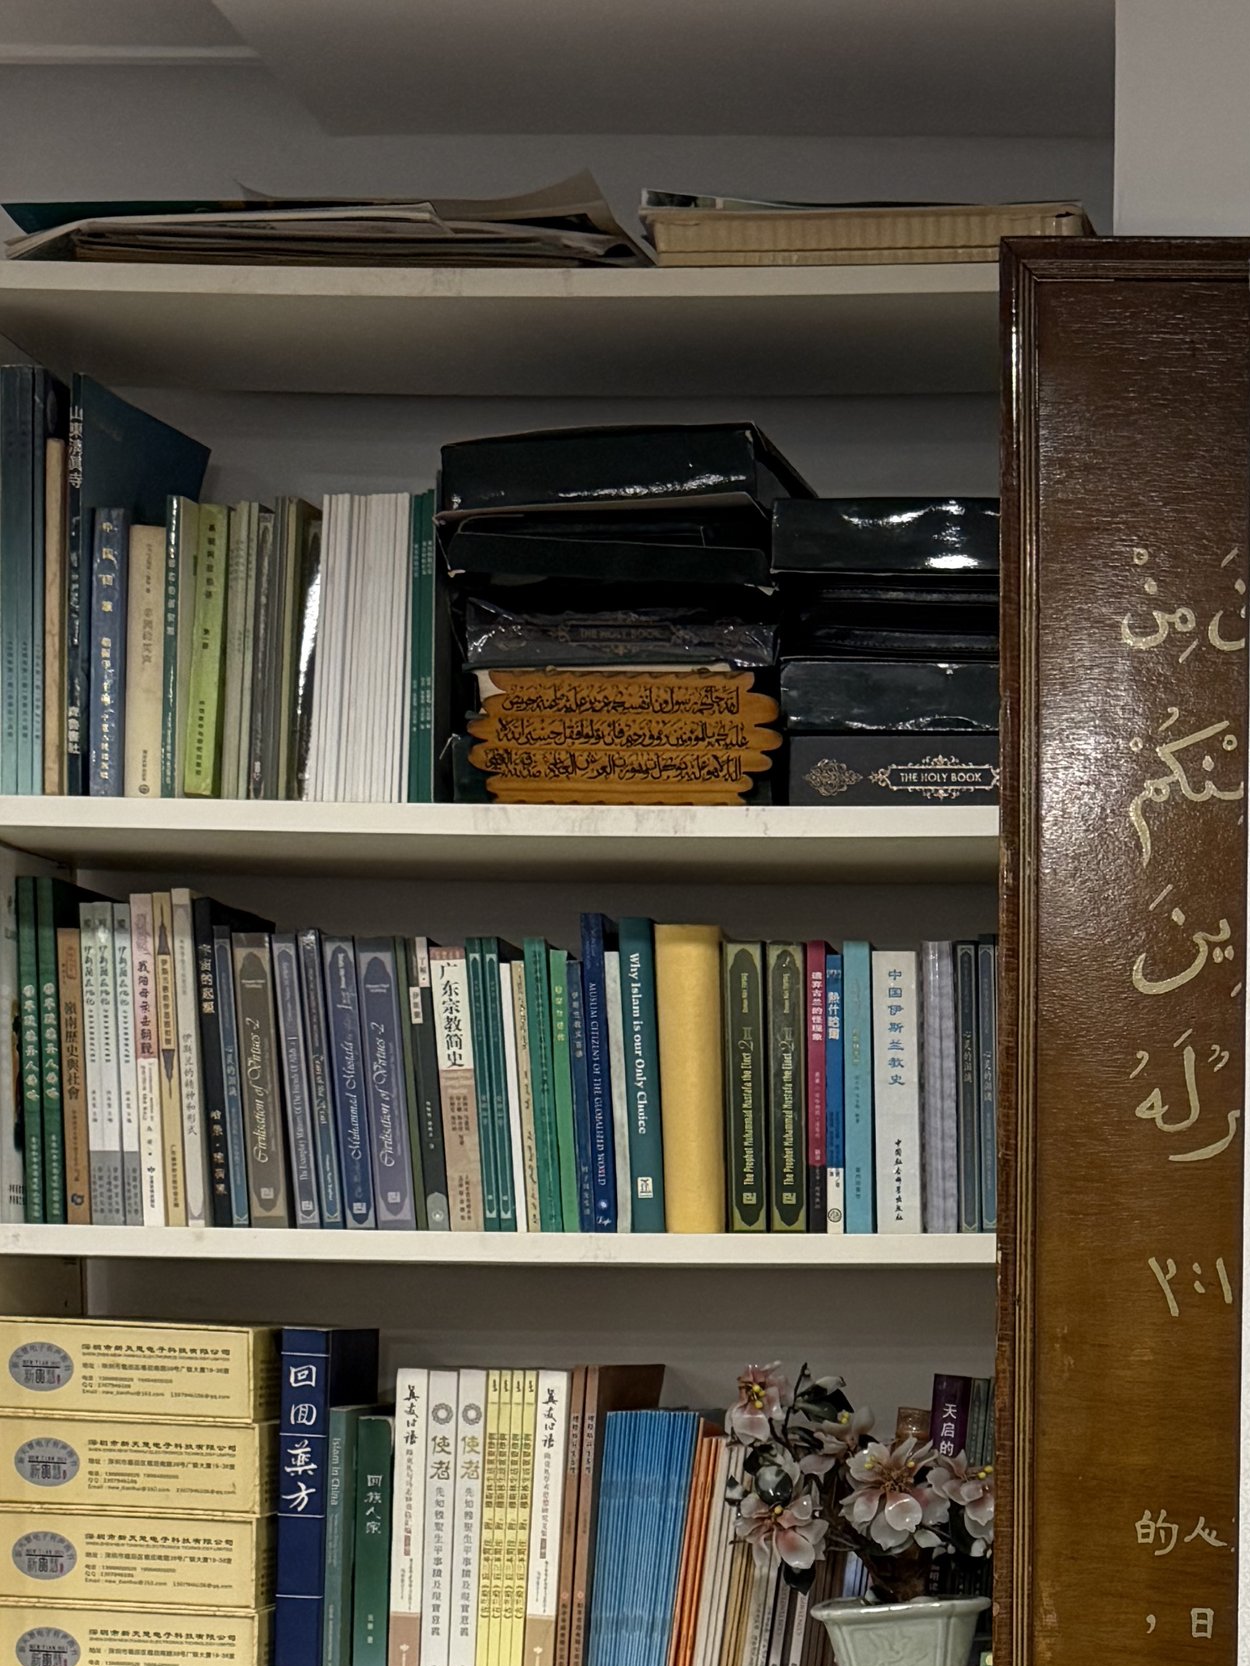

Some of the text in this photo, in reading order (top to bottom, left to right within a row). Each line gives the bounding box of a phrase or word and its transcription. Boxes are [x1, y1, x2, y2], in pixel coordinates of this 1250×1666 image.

[900, 772, 982, 783] THE HOLY BOOK
[440, 962, 465, 1069] 广东宗教简史
[588, 983, 598, 1018] MUSLIM
[590, 1021, 600, 1060] CITIZENS
[627, 952, 648, 1135] Why Islam is our Only Choice
[887, 969, 906, 1086] 中国伊斯兰教史
[63, 1001, 80, 1101] 嶺南歷史與社會
[372, 1039, 387, 1085] Virtues
[741, 1052, 752, 1069] Elect
[592, 1064, 600, 1074] OF
[592, 1078, 601, 1094] THE
[742, 1070, 752, 1081] the
[781, 1070, 793, 1081] the
[250, 1080, 269, 1097] of
[375, 1085, 394, 1102] of
[742, 1082, 753, 1109] Mustafa
[781, 1082, 793, 1109] Mustafa
[252, 1100, 269, 1163] Civilisation
[378, 1103, 395, 1168] Civilisation
[742, 1110, 754, 1146] Muhammad
[782, 1110, 794, 1146] Muhammad
[596, 1154, 607, 1186] WORLD
[743, 1147, 755, 1173] Prophet
[783, 1147, 795, 1173] Prophet
[743, 1173, 755, 1185] The
[783, 1173, 795, 1185] The
[940, 1403, 957, 1457] 天启的
[330, 1438, 341, 1506] Islam in China
[429, 1435, 452, 1481] 使者
[460, 1436, 482, 1481] 使者
[364, 1475, 383, 1534] 回族人家
